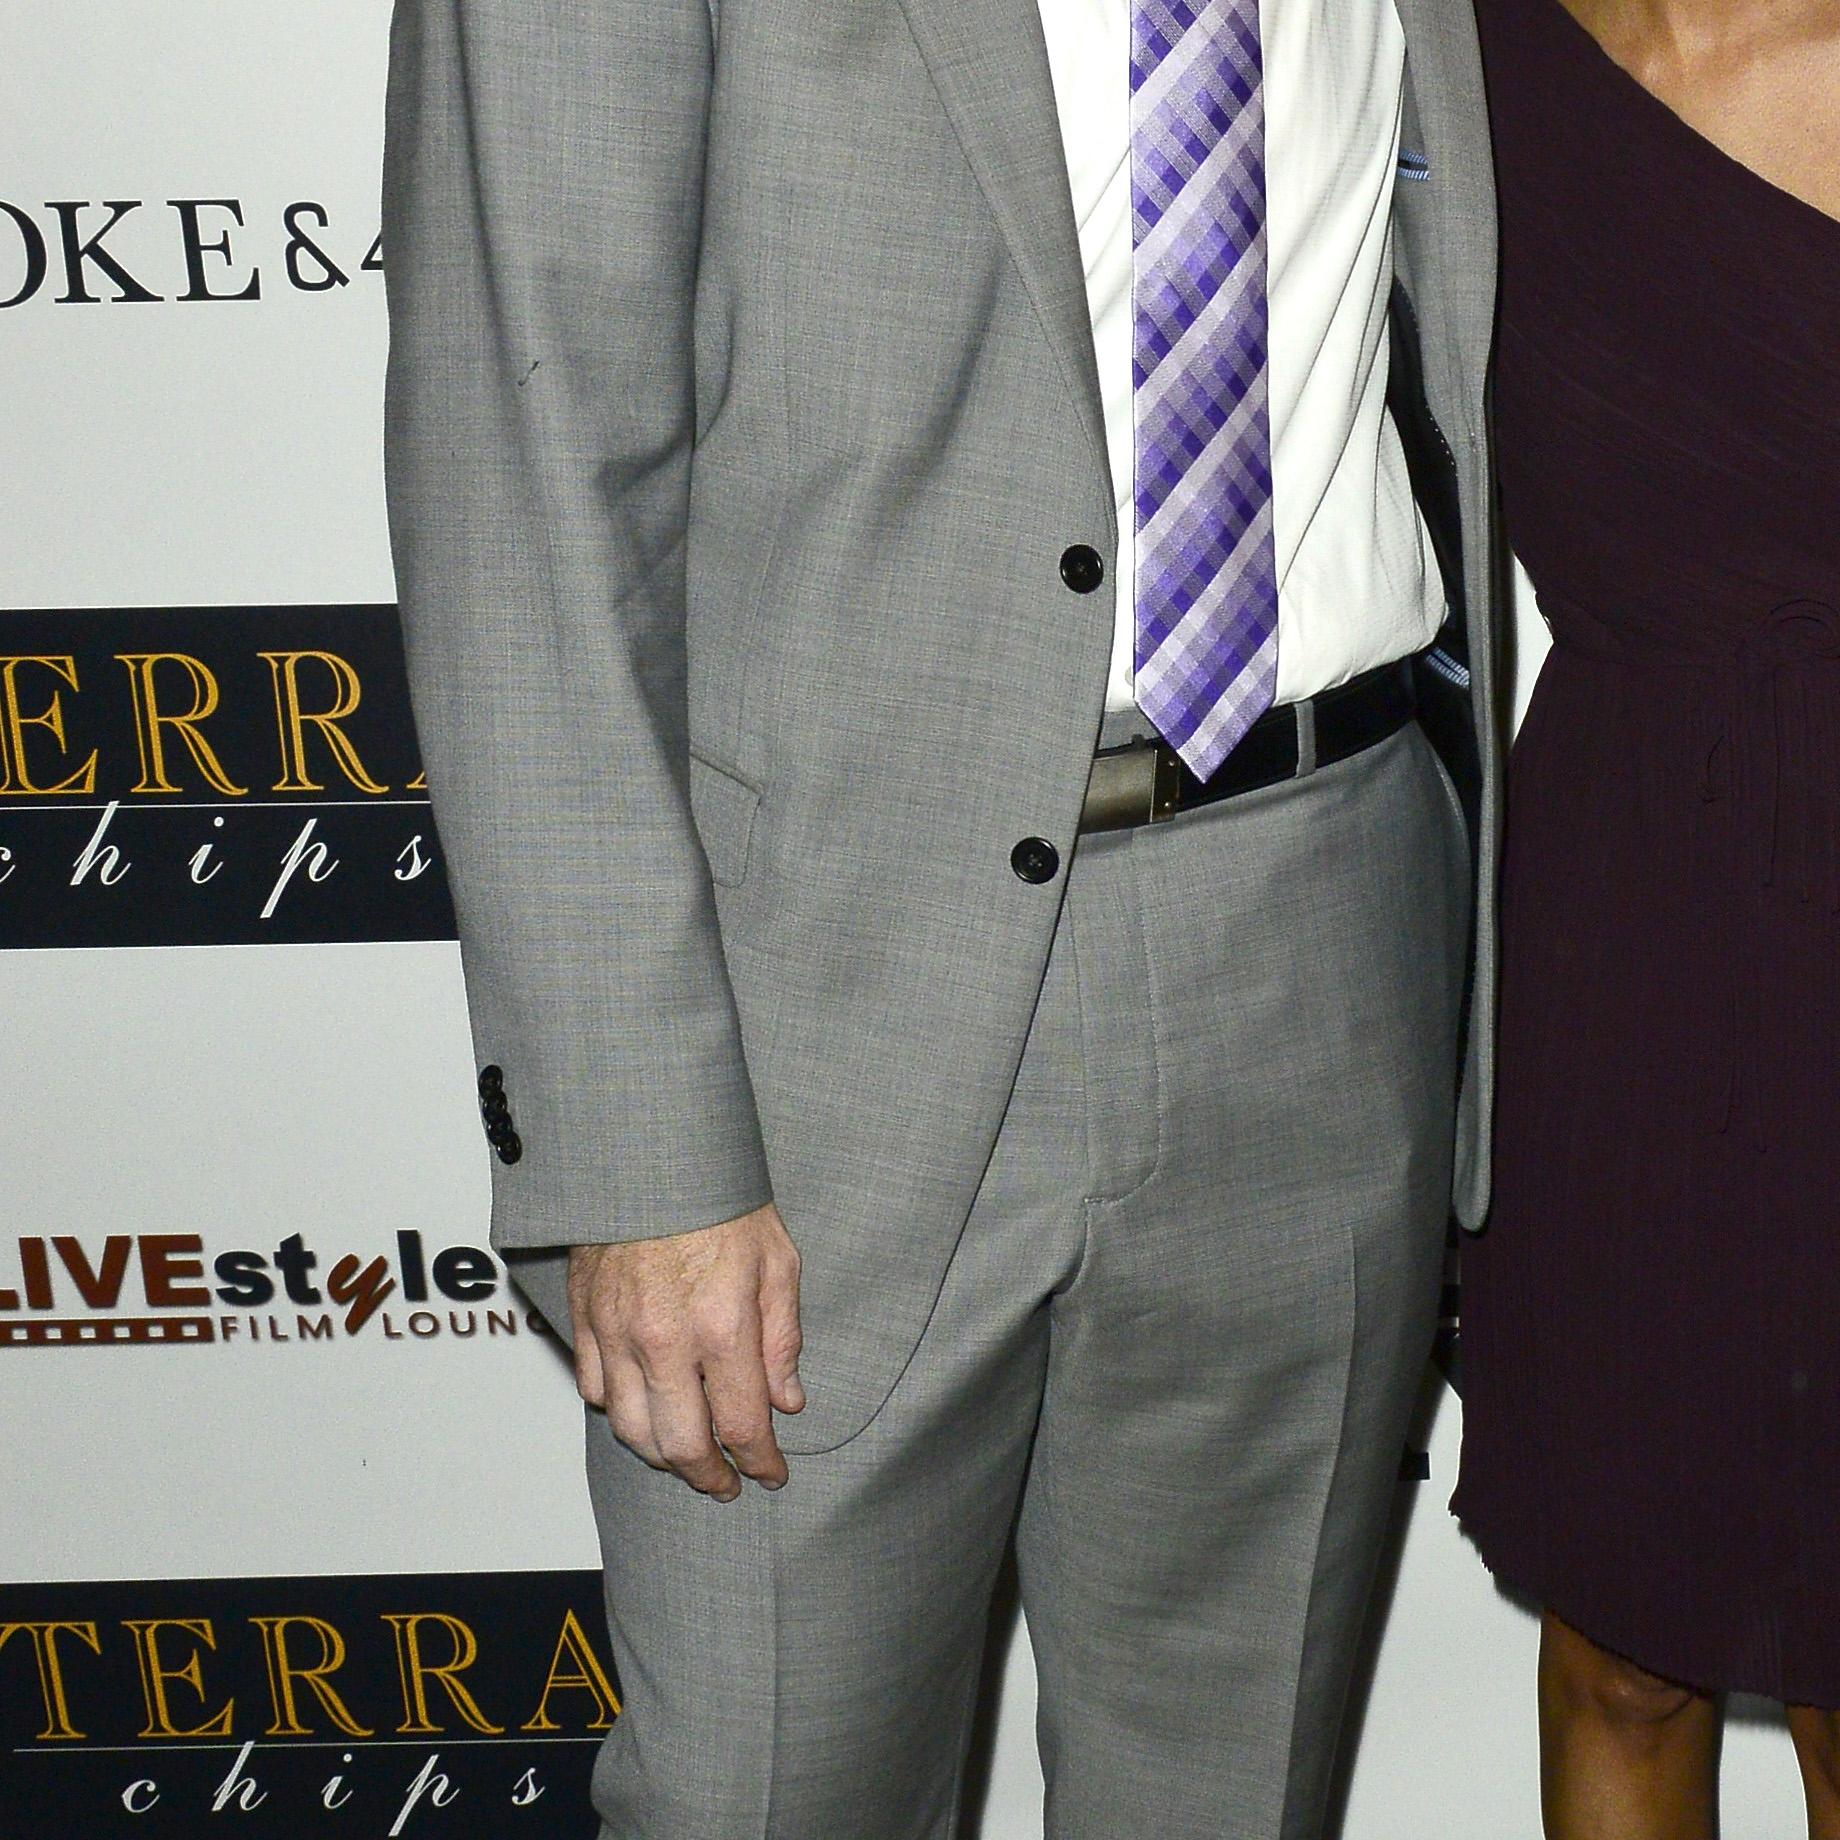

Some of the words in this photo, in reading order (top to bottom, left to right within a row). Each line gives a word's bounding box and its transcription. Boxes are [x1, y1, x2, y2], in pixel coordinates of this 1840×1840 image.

[221, 1313, 333, 1341] FILM
[0, 1608, 623, 1740] TERRA
[121, 1740, 544, 1836] chips
